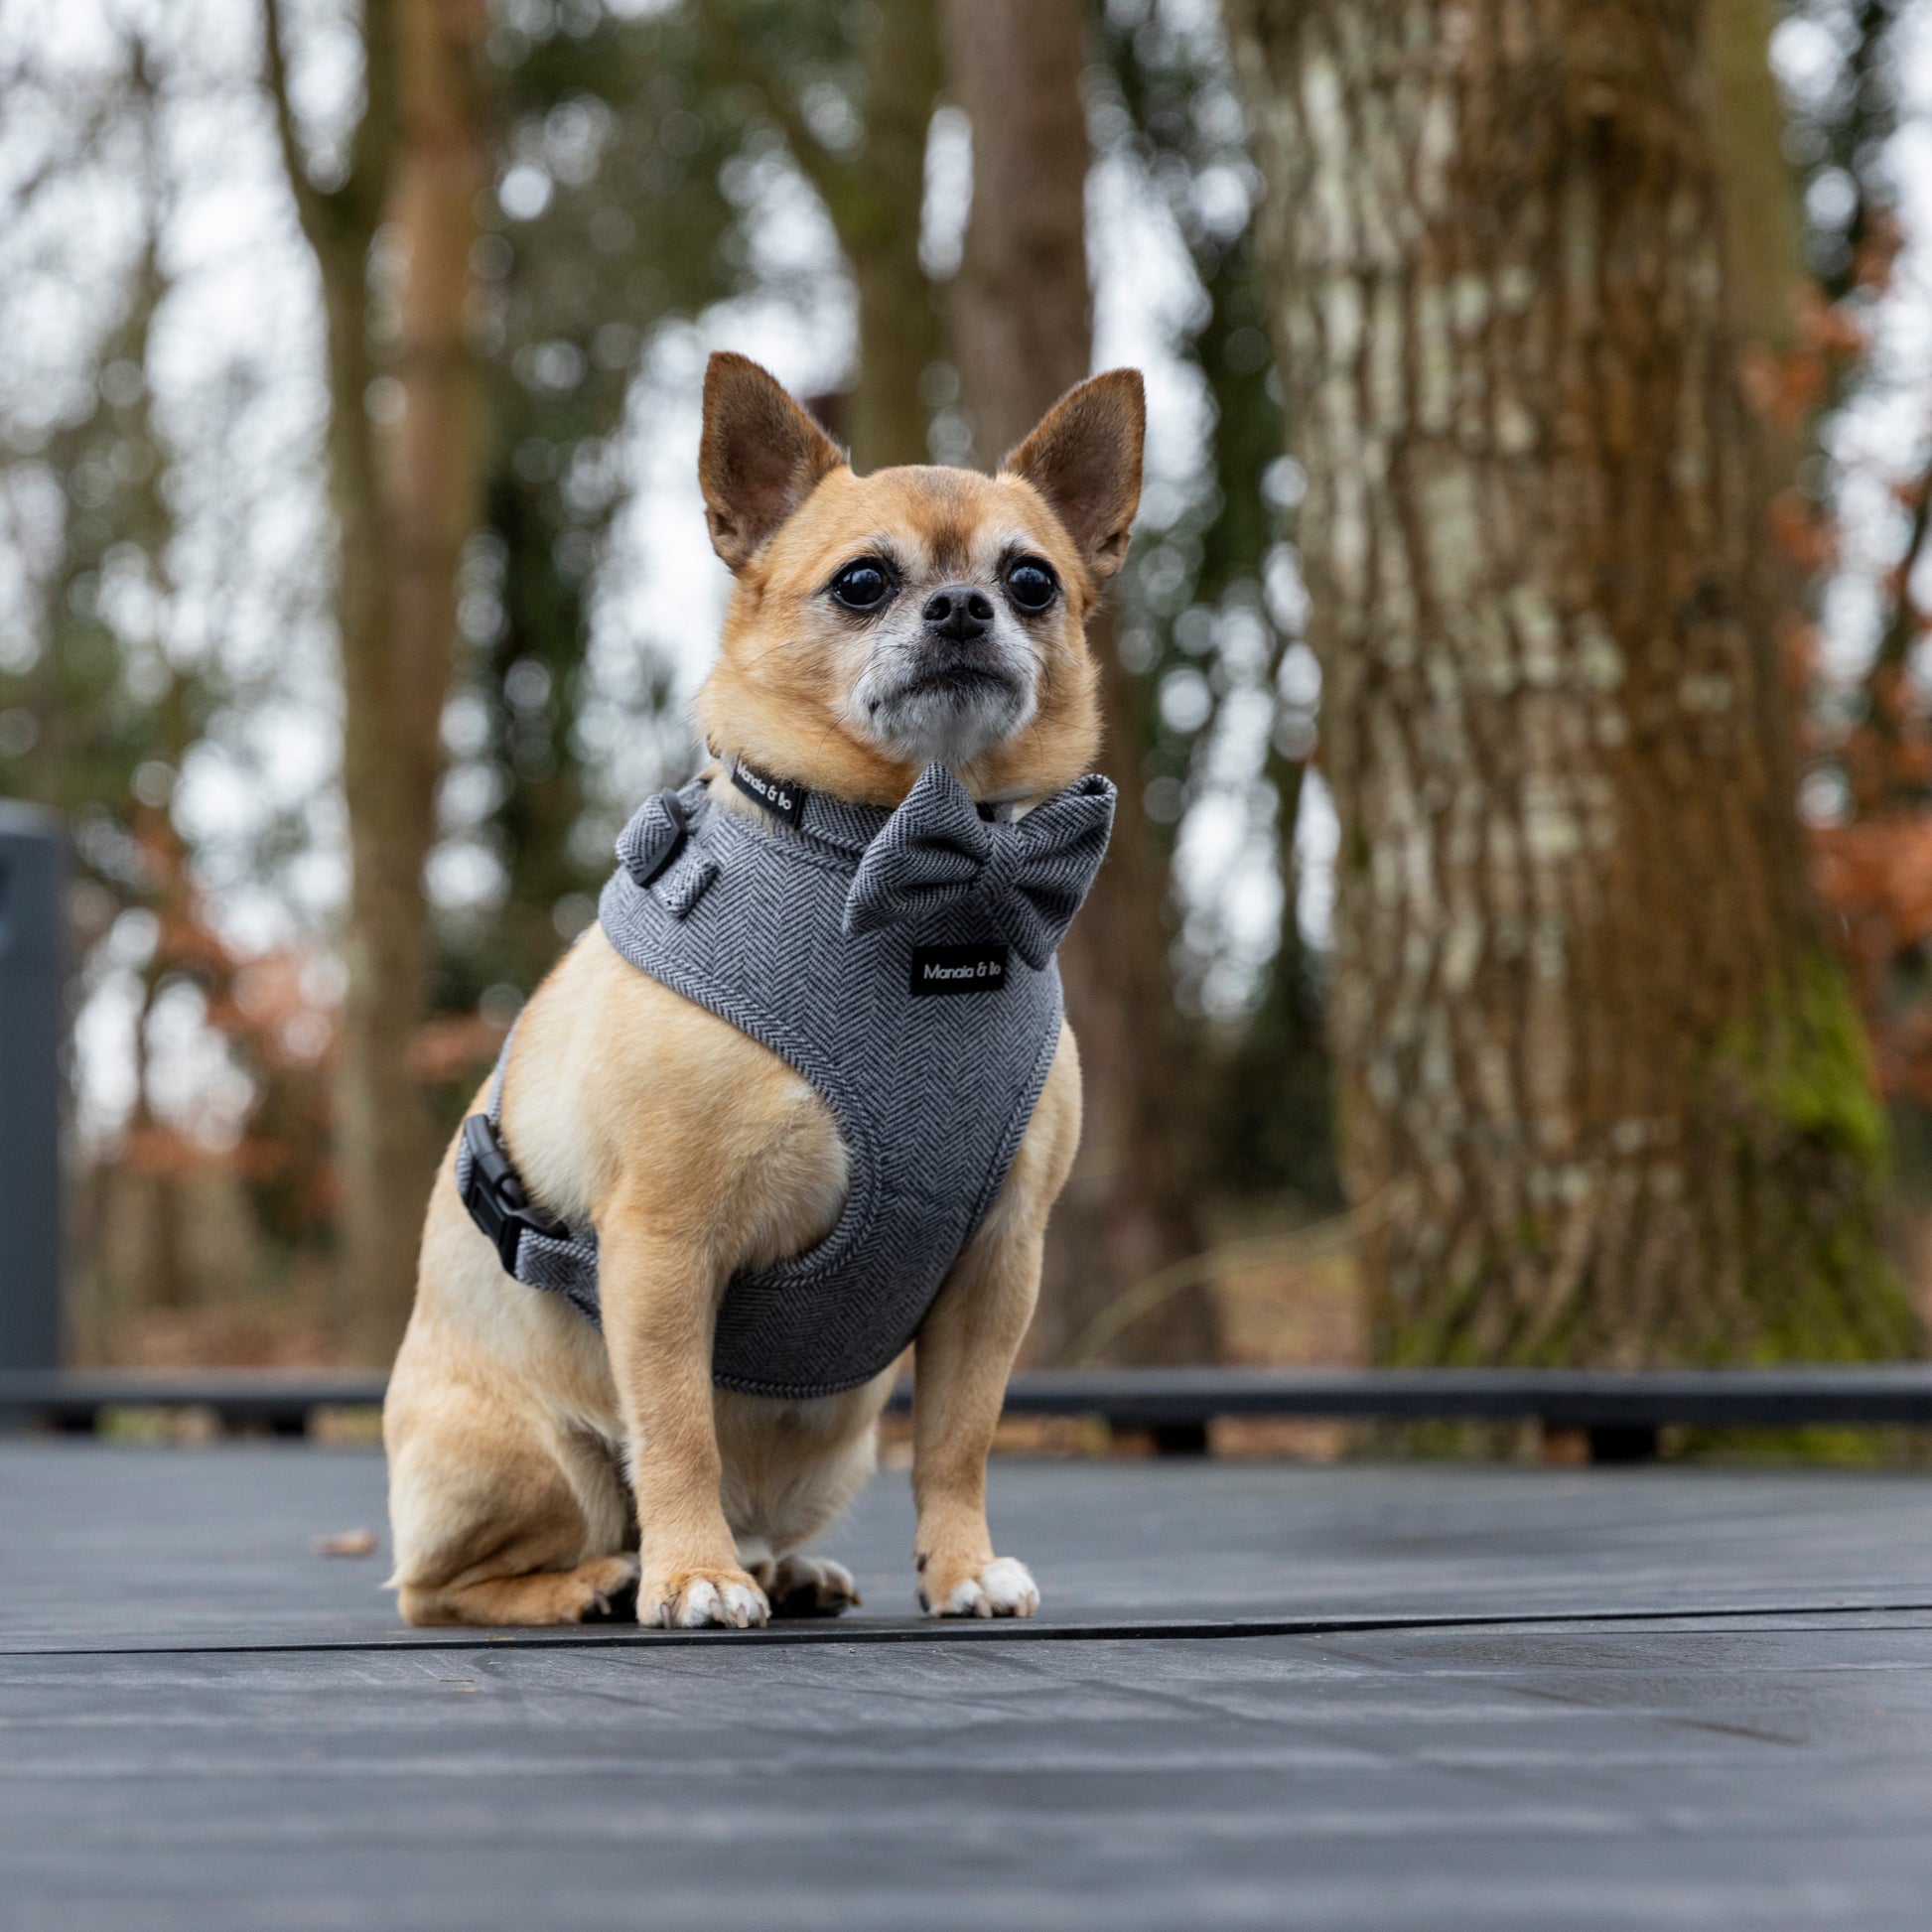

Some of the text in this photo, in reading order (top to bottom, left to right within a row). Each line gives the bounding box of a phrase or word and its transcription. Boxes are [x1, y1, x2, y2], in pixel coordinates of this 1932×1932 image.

[767, 785, 778, 801] &
[923, 963, 975, 979] Manaia
[977, 962, 988, 977] &
